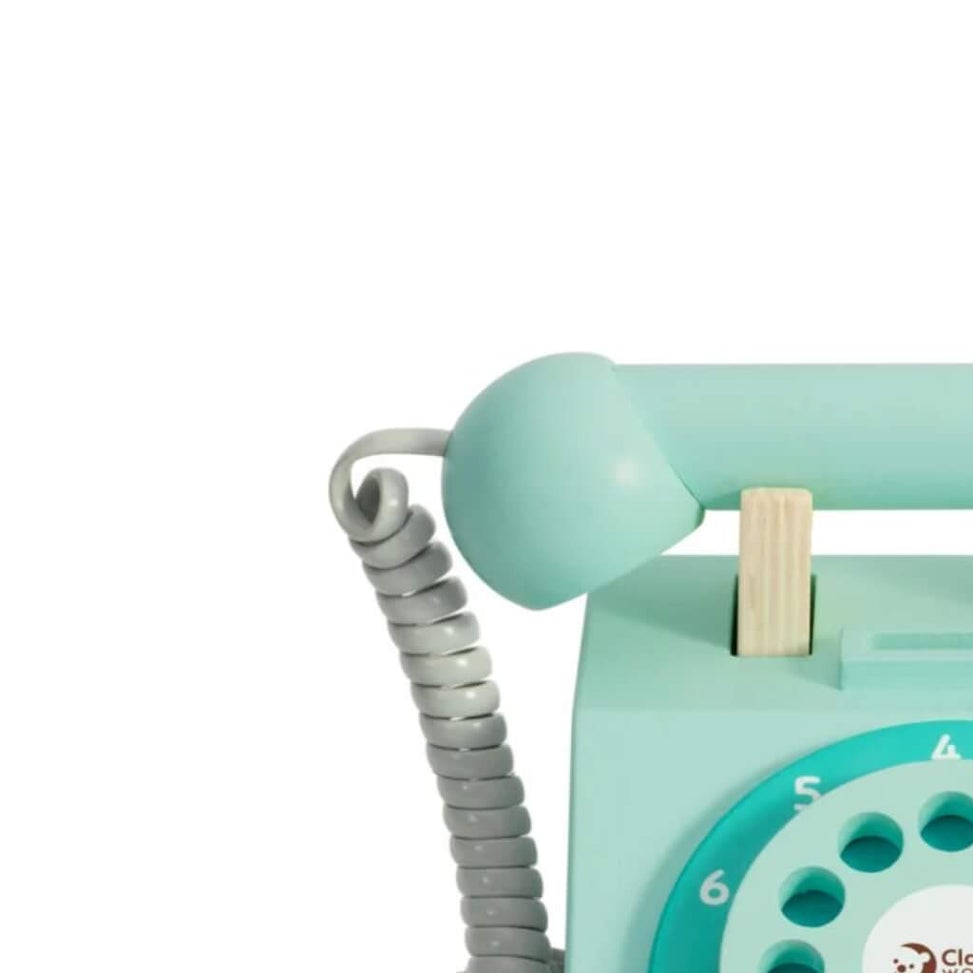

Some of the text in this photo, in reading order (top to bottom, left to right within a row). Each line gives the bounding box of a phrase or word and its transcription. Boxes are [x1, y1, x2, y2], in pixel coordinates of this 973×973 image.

[931, 734, 961, 760] 4
[794, 776, 821, 811] 5
[700, 869, 730, 905] 6
